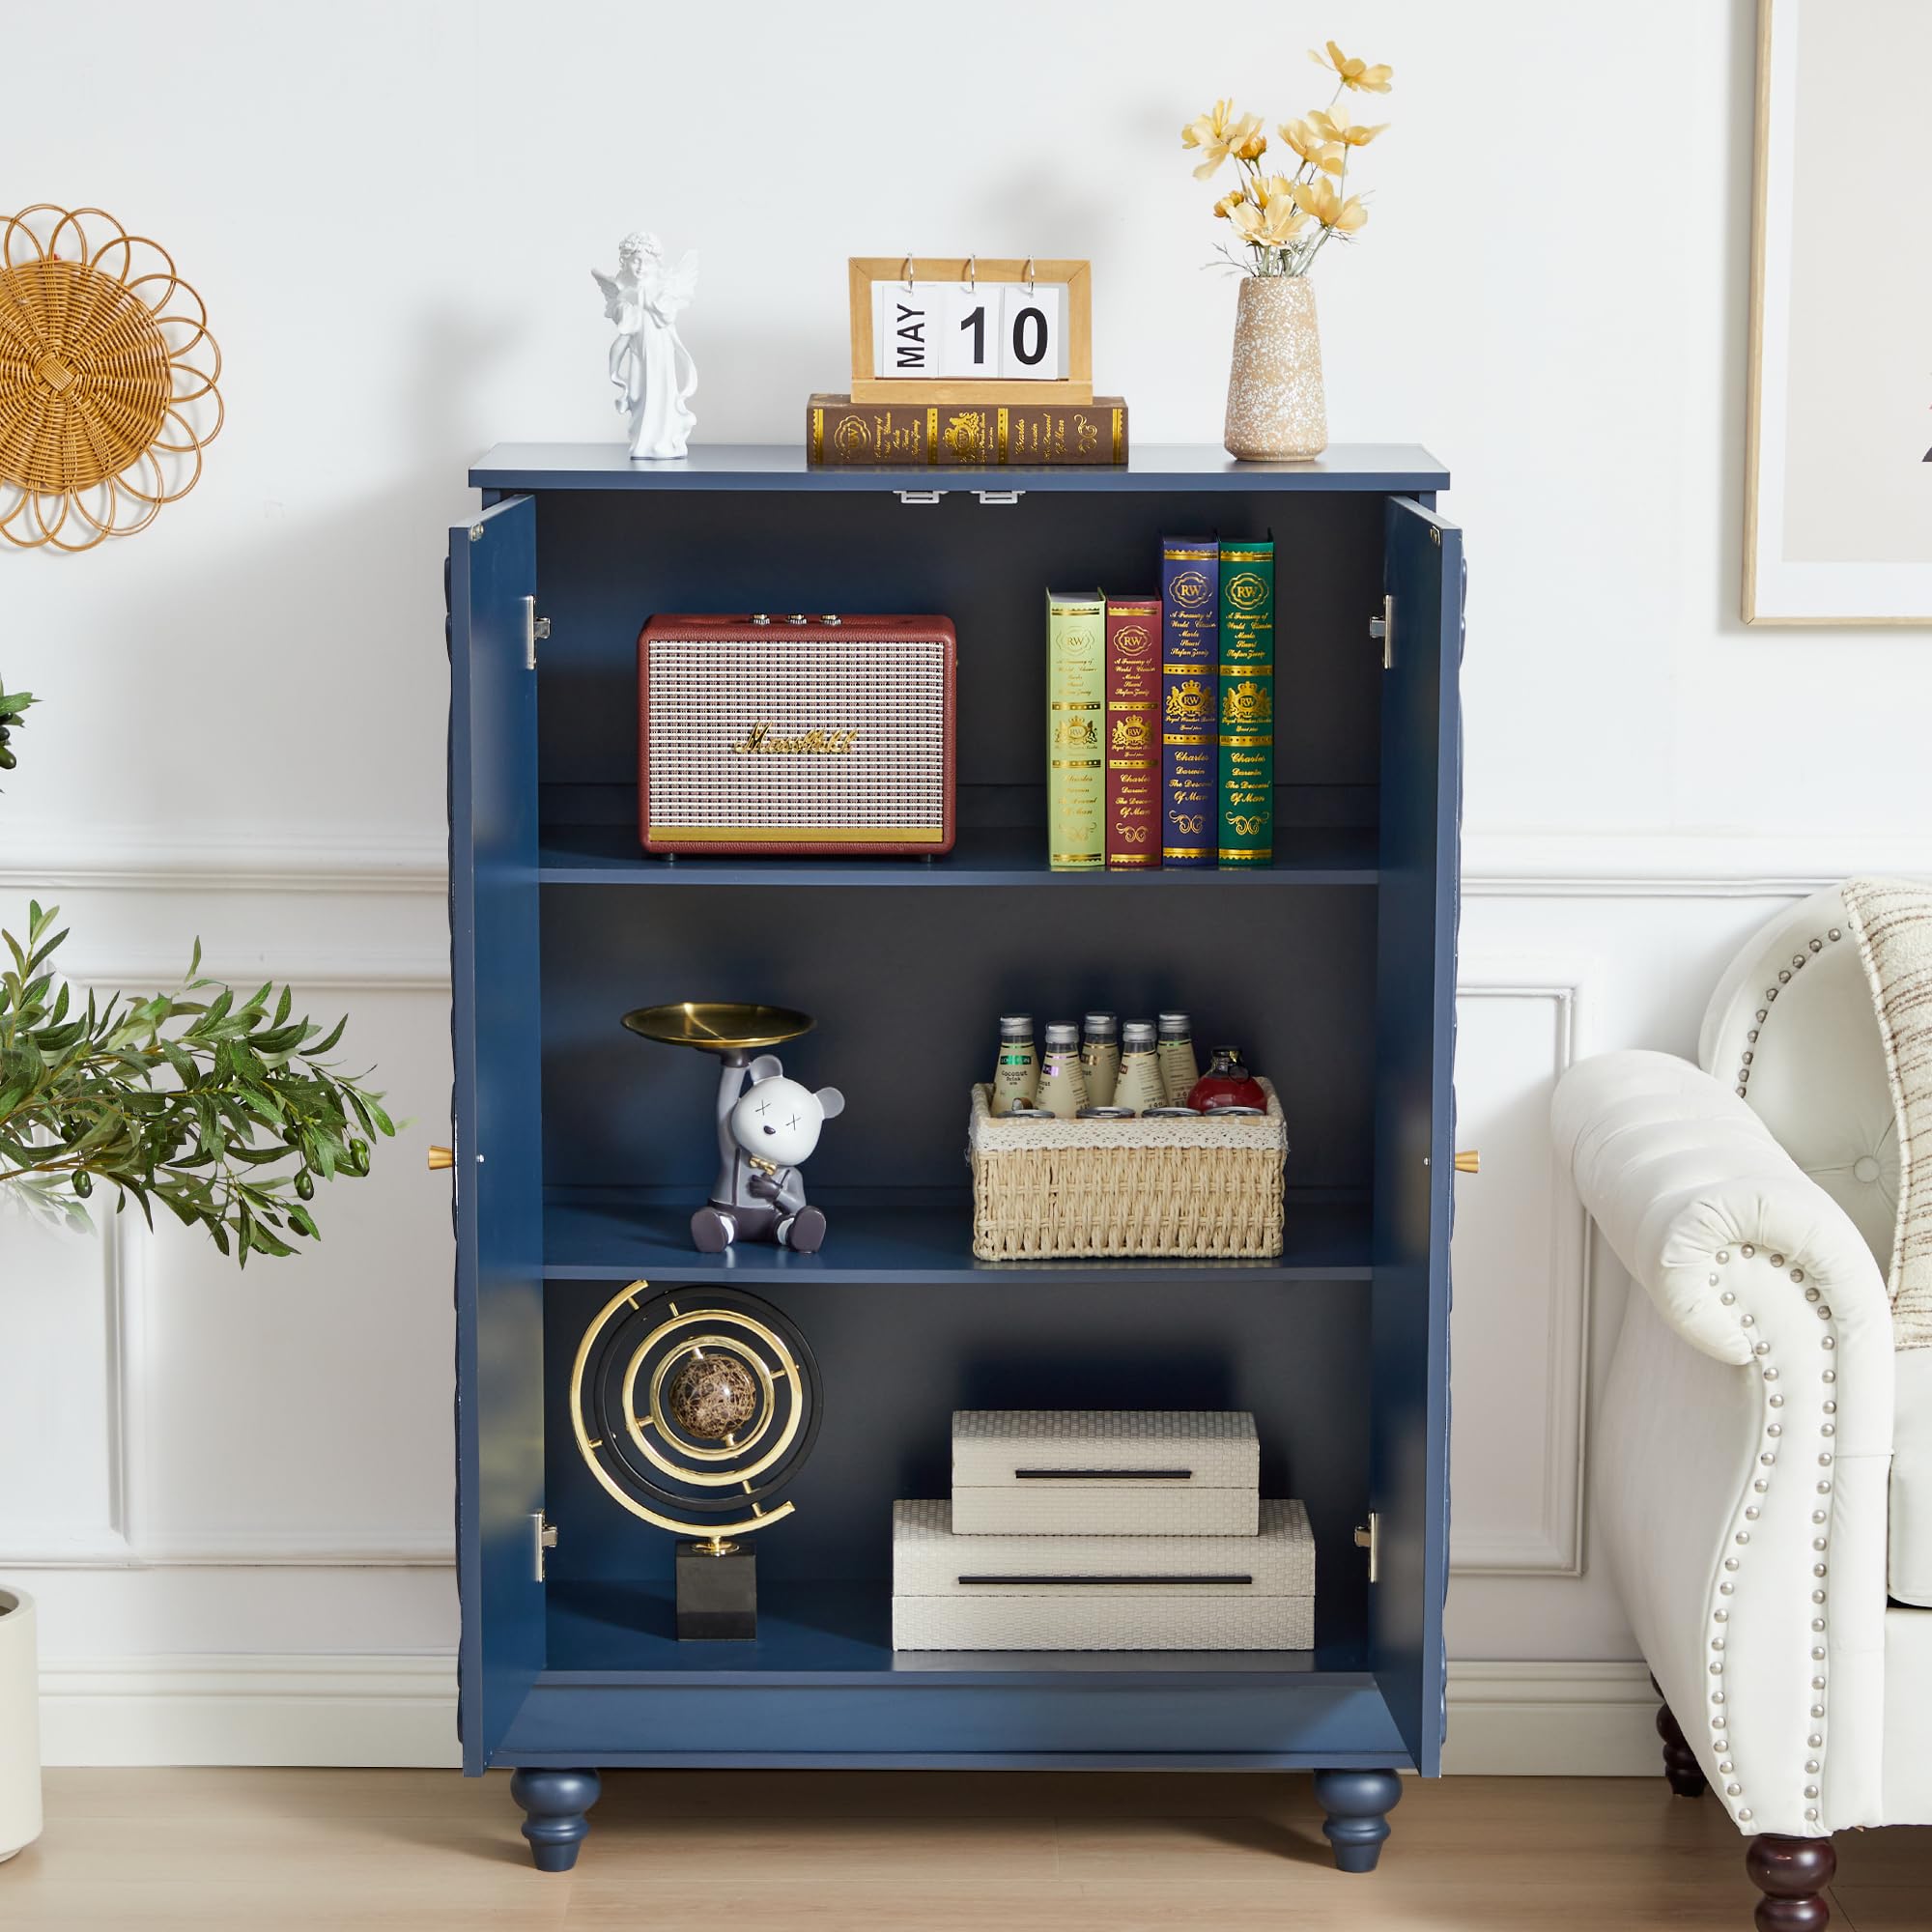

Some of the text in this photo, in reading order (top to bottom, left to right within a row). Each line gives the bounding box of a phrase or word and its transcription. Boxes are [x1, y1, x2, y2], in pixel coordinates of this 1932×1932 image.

[896, 303, 925, 368] MAY
[960, 306, 1048, 365] 10
[1181, 585, 1202, 596] RW
[1236, 586, 1258, 597] RW
[1123, 637, 1144, 646] RW
[1127, 728, 1142, 737] RW
[1175, 752, 1208, 762] Charles
[1231, 752, 1265, 763] Charles
[1176, 766, 1206, 775] Darwin
[1232, 768, 1262, 777] Darwin
[1120, 774, 1151, 783] Charles
[1169, 779, 1183, 788] The
[1225, 780, 1270, 789] The Descent
[1174, 790, 1208, 805] Of Man
[1230, 791, 1265, 806] Of Man
[1120, 807, 1151, 818] Of Man
